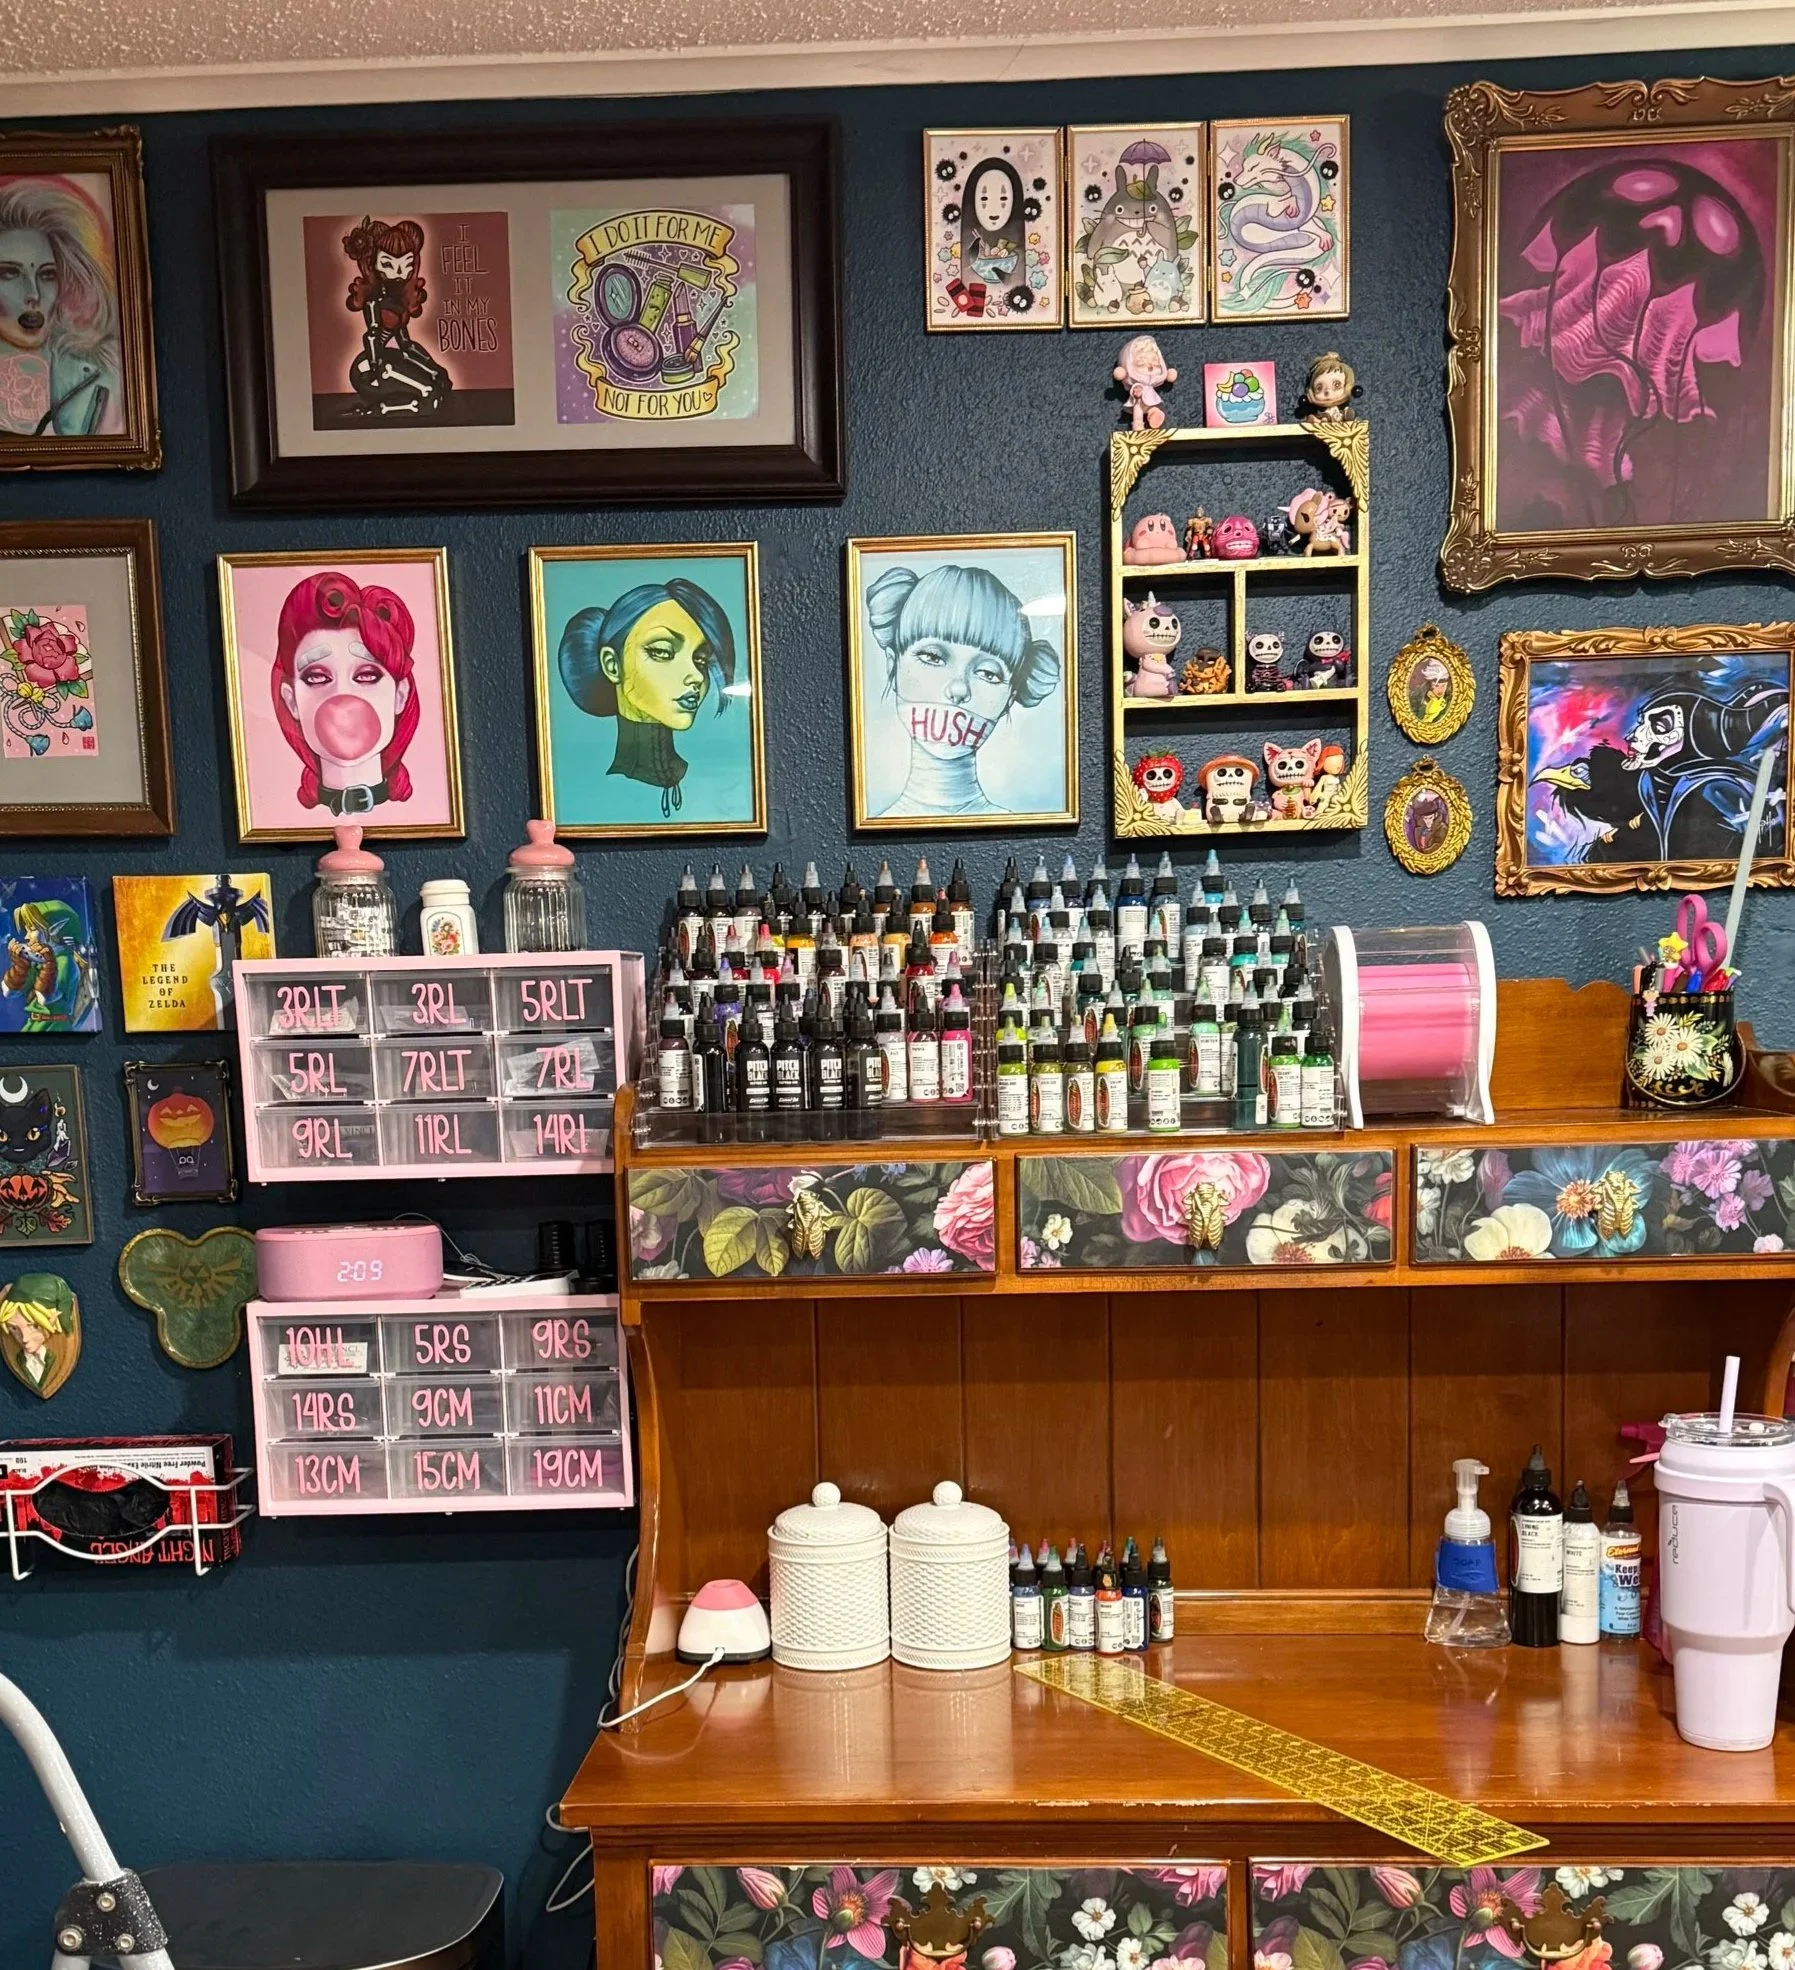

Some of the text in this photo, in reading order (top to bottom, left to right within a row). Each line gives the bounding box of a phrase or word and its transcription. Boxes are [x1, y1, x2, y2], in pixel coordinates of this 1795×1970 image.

[457, 224, 470, 243] I
[589, 215, 723, 256] I DO IT FOR ME
[441, 244, 489, 274] FEEL
[443, 296, 490, 315] IN MY
[454, 276, 472, 295] IT
[437, 318, 499, 352] BONES
[603, 387, 701, 416] NOT FOR YOU
[911, 707, 987, 747] HUSH
[142, 976, 188, 984] LEGEND
[152, 964, 176, 972] THE
[149, 1000, 186, 1008] ZELDA
[159, 988, 173, 996] OF
[277, 985, 347, 1029] 3RLT
[411, 983, 467, 1024] 3RL
[521, 978, 593, 1022] 5RLT
[289, 1051, 347, 1094] 5RL
[401, 1048, 472, 1093] 7RLT
[536, 1046, 593, 1089] 7RL
[292, 1117, 352, 1158] 9RL
[415, 1113, 472, 1155] 11RL
[533, 1113, 588, 1154] 14RL
[337, 1260, 383, 1283] 2:09
[286, 1326, 354, 1369] 10HL
[414, 1323, 471, 1365] 5RS
[531, 1318, 592, 1359] 9RS
[292, 1391, 356, 1432] 14RS
[411, 1387, 473, 1428] 9CM
[534, 1384, 592, 1425] 11CM
[179, 1460, 206, 1469] Powder
[295, 1454, 361, 1495] 13CM
[414, 1450, 480, 1491] 15CM
[533, 1448, 603, 1490] 19CM
[158, 1538, 215, 1563] NGHT
[1615, 1564, 1638, 1576] Keep
[1618, 1574, 1640, 1587] We
